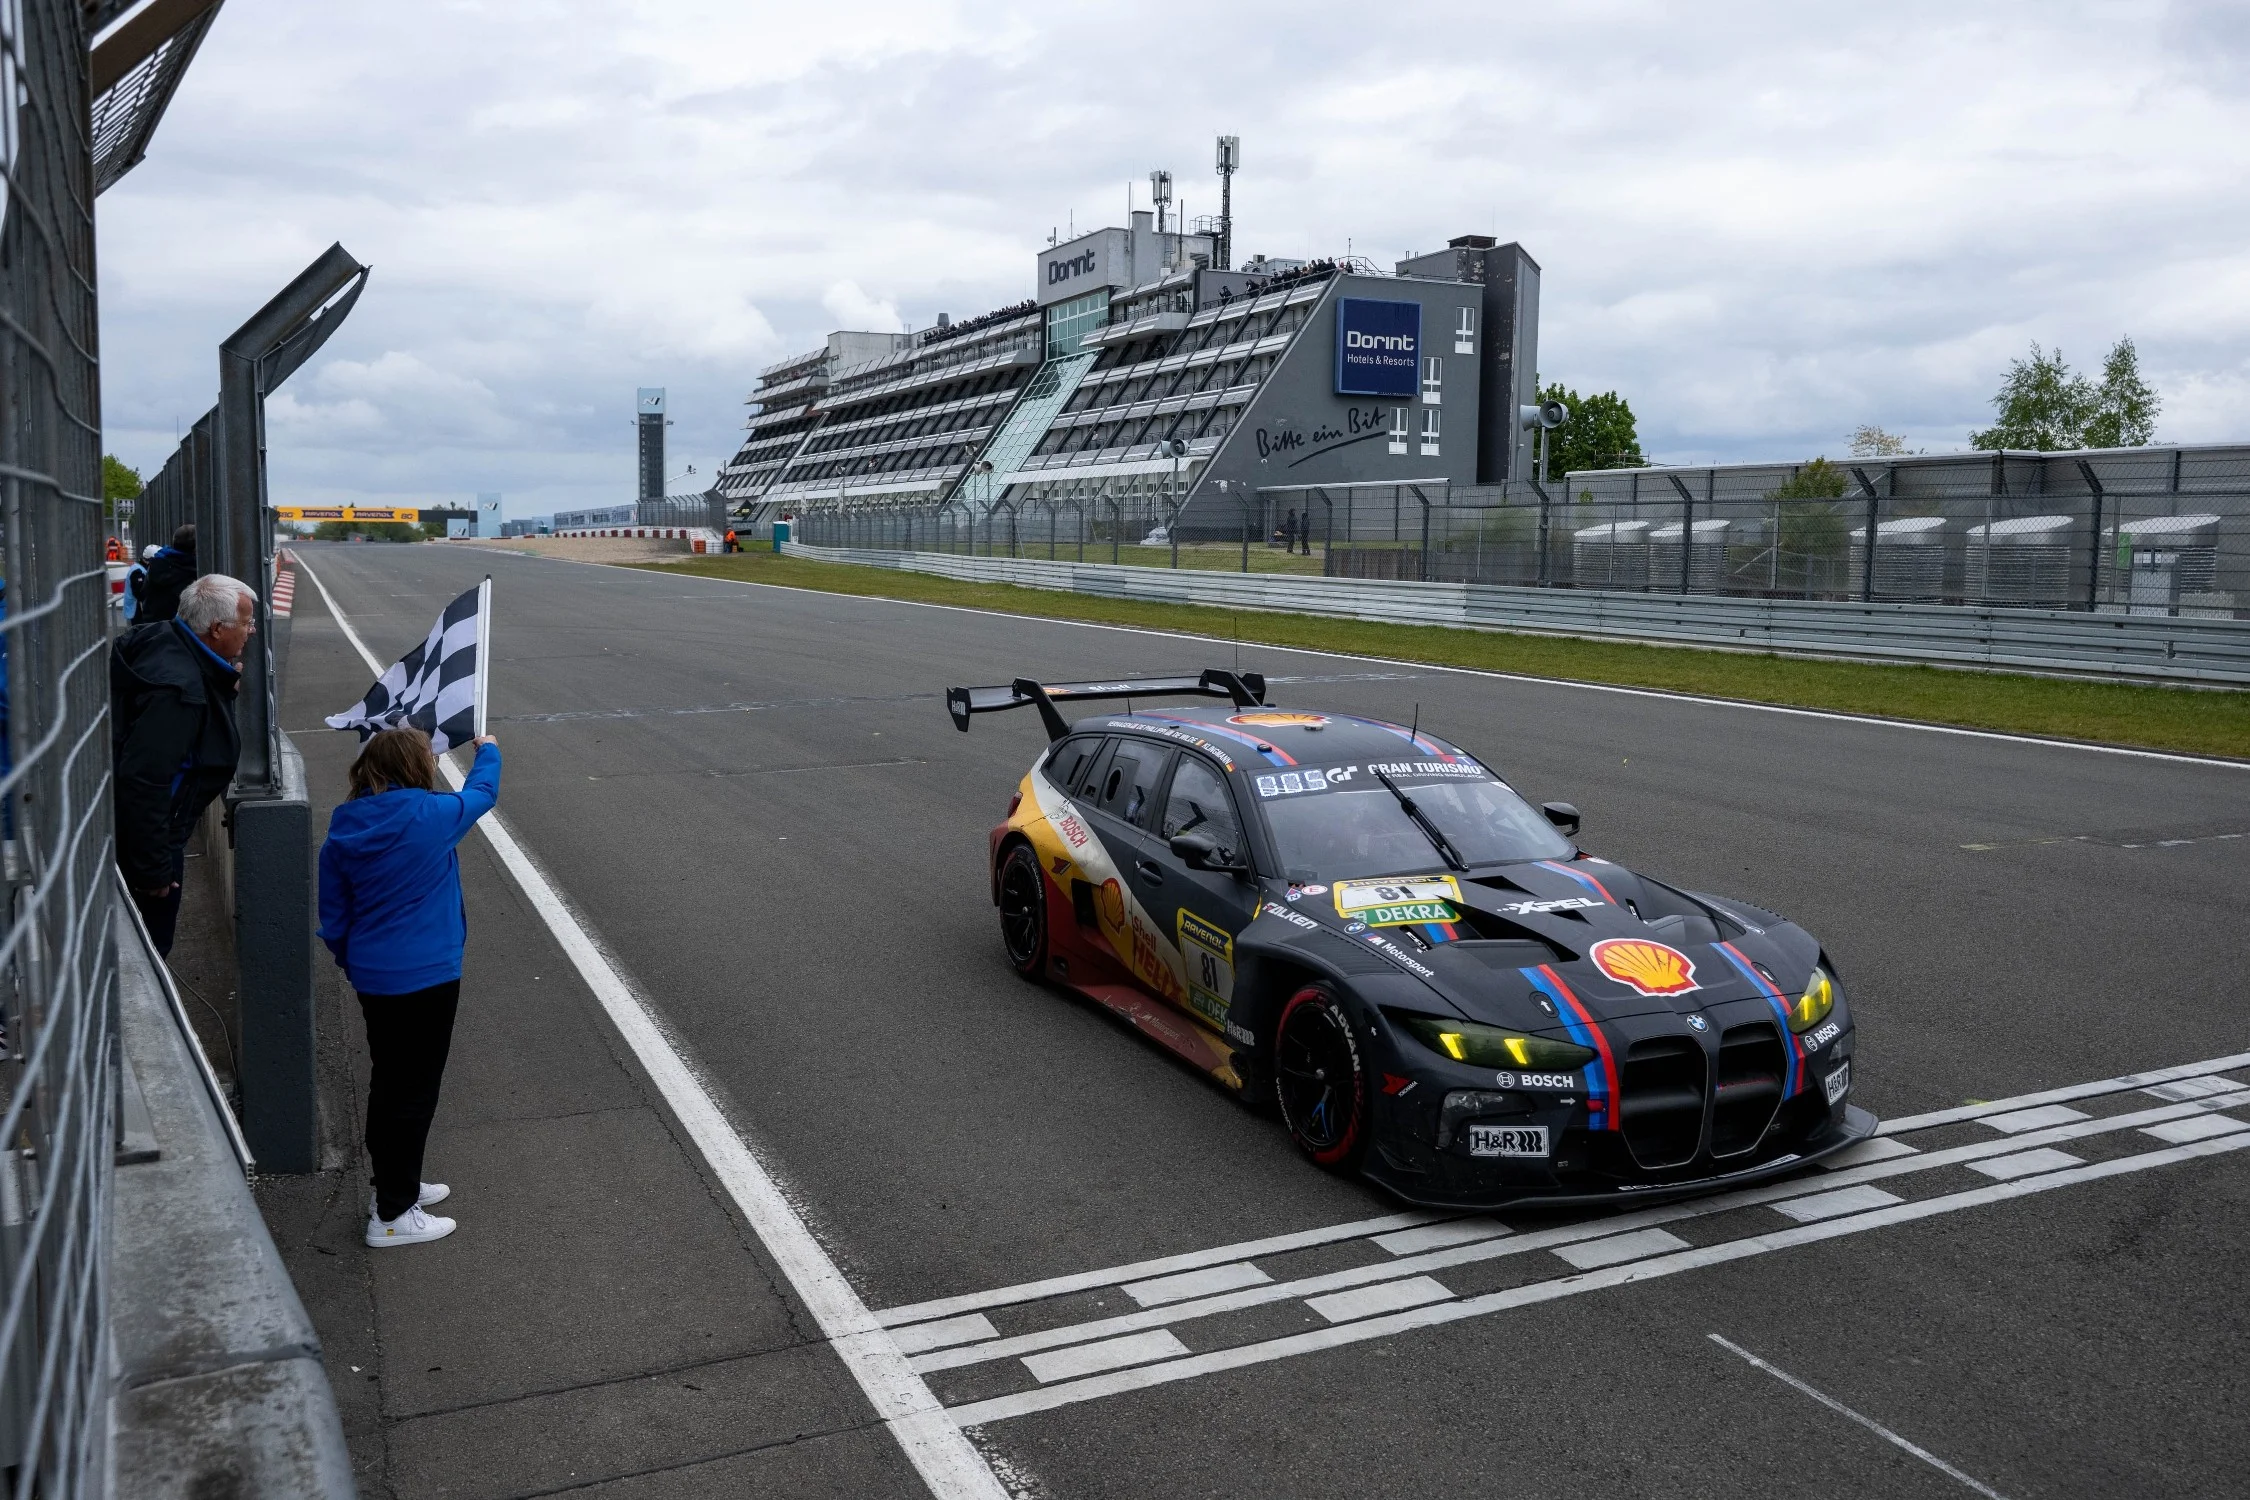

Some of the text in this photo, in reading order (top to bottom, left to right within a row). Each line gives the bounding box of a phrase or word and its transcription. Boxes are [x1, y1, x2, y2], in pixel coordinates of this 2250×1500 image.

[1048, 248, 1095, 285] Dorint
[1346, 330, 1415, 351] Dorint
[1347, 353, 1415, 367] Hotels & Resorts
[1256, 406, 1386, 458] Bitte ein Bit
[1368, 762, 1412, 775] GRAN
[1060, 816, 1089, 848] BOSCH
[1375, 886, 1416, 901] 81
[1517, 897, 1605, 915] XPEL
[1263, 902, 1319, 930] FALKEN
[1375, 904, 1451, 922] DEKRA
[1133, 916, 1156, 952] Shell
[1183, 920, 1224, 949] RAVENOL
[1201, 952, 1219, 993] 81
[1381, 943, 1435, 977] Motorsport
[1329, 1004, 1361, 1072] ADVAN
[1814, 1022, 1841, 1044] BOSCH
[1521, 1074, 1574, 1088] BOSCH
[1828, 1070, 1843, 1099] H&R
[1474, 1131, 1528, 1151] H&R
